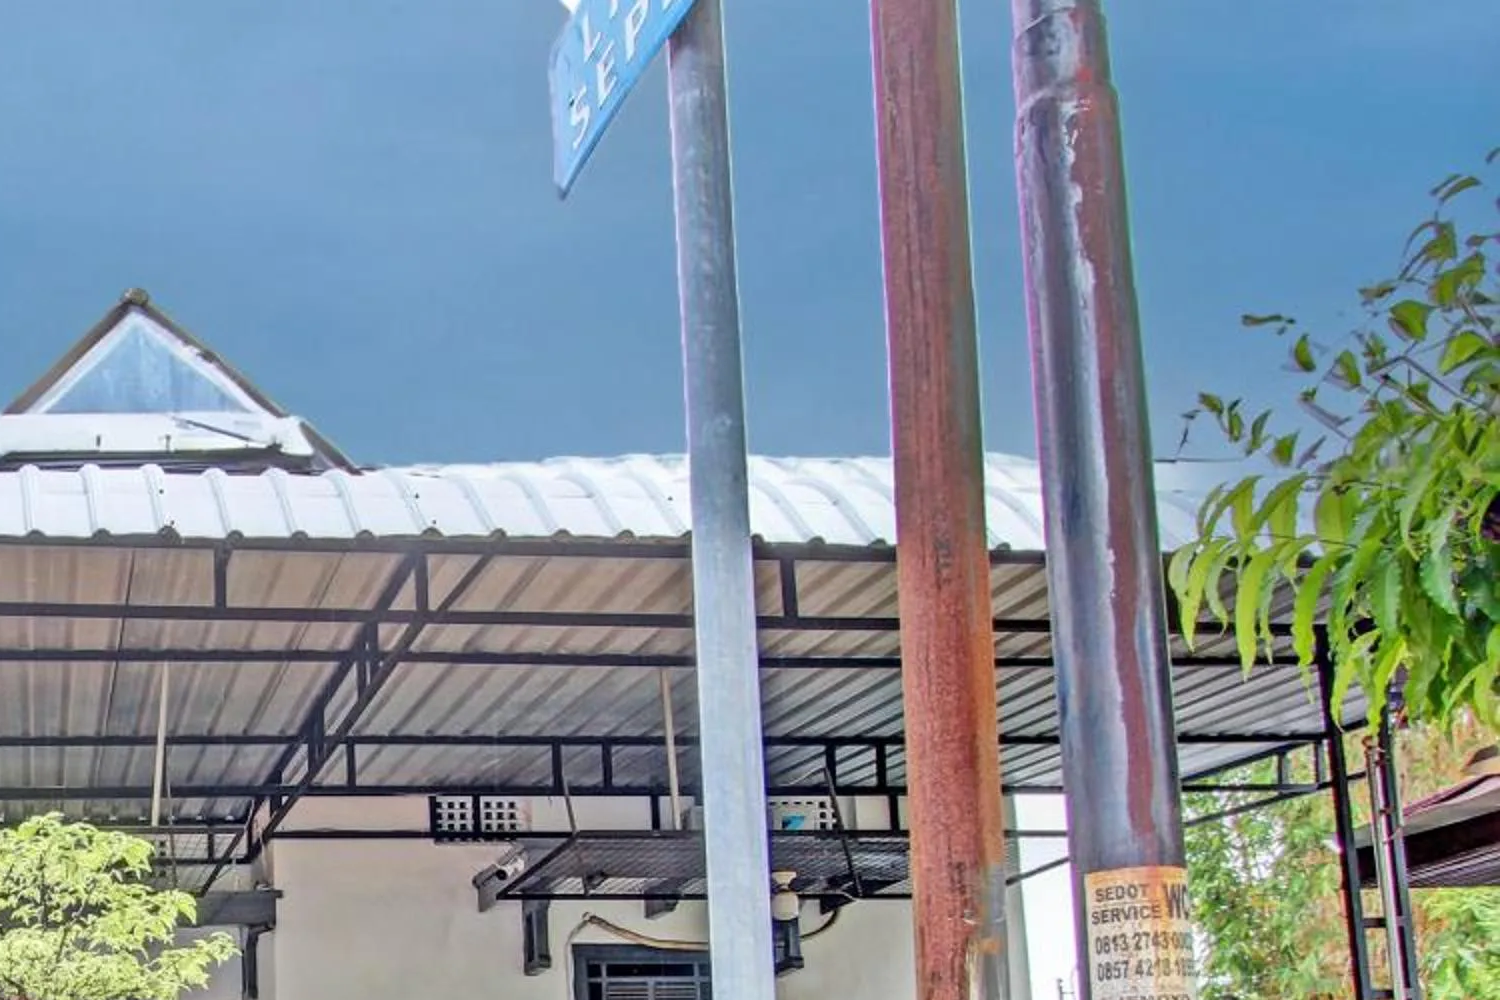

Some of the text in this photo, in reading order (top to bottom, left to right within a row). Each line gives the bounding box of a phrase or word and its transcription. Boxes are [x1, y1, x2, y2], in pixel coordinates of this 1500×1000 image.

[569, 0, 674, 150] SEP
[1095, 883, 1150, 902] SEDOT
[1092, 904, 1162, 925] SERVICE
[1095, 933, 1129, 955] 0813
[1097, 960, 1129, 982] 0857
